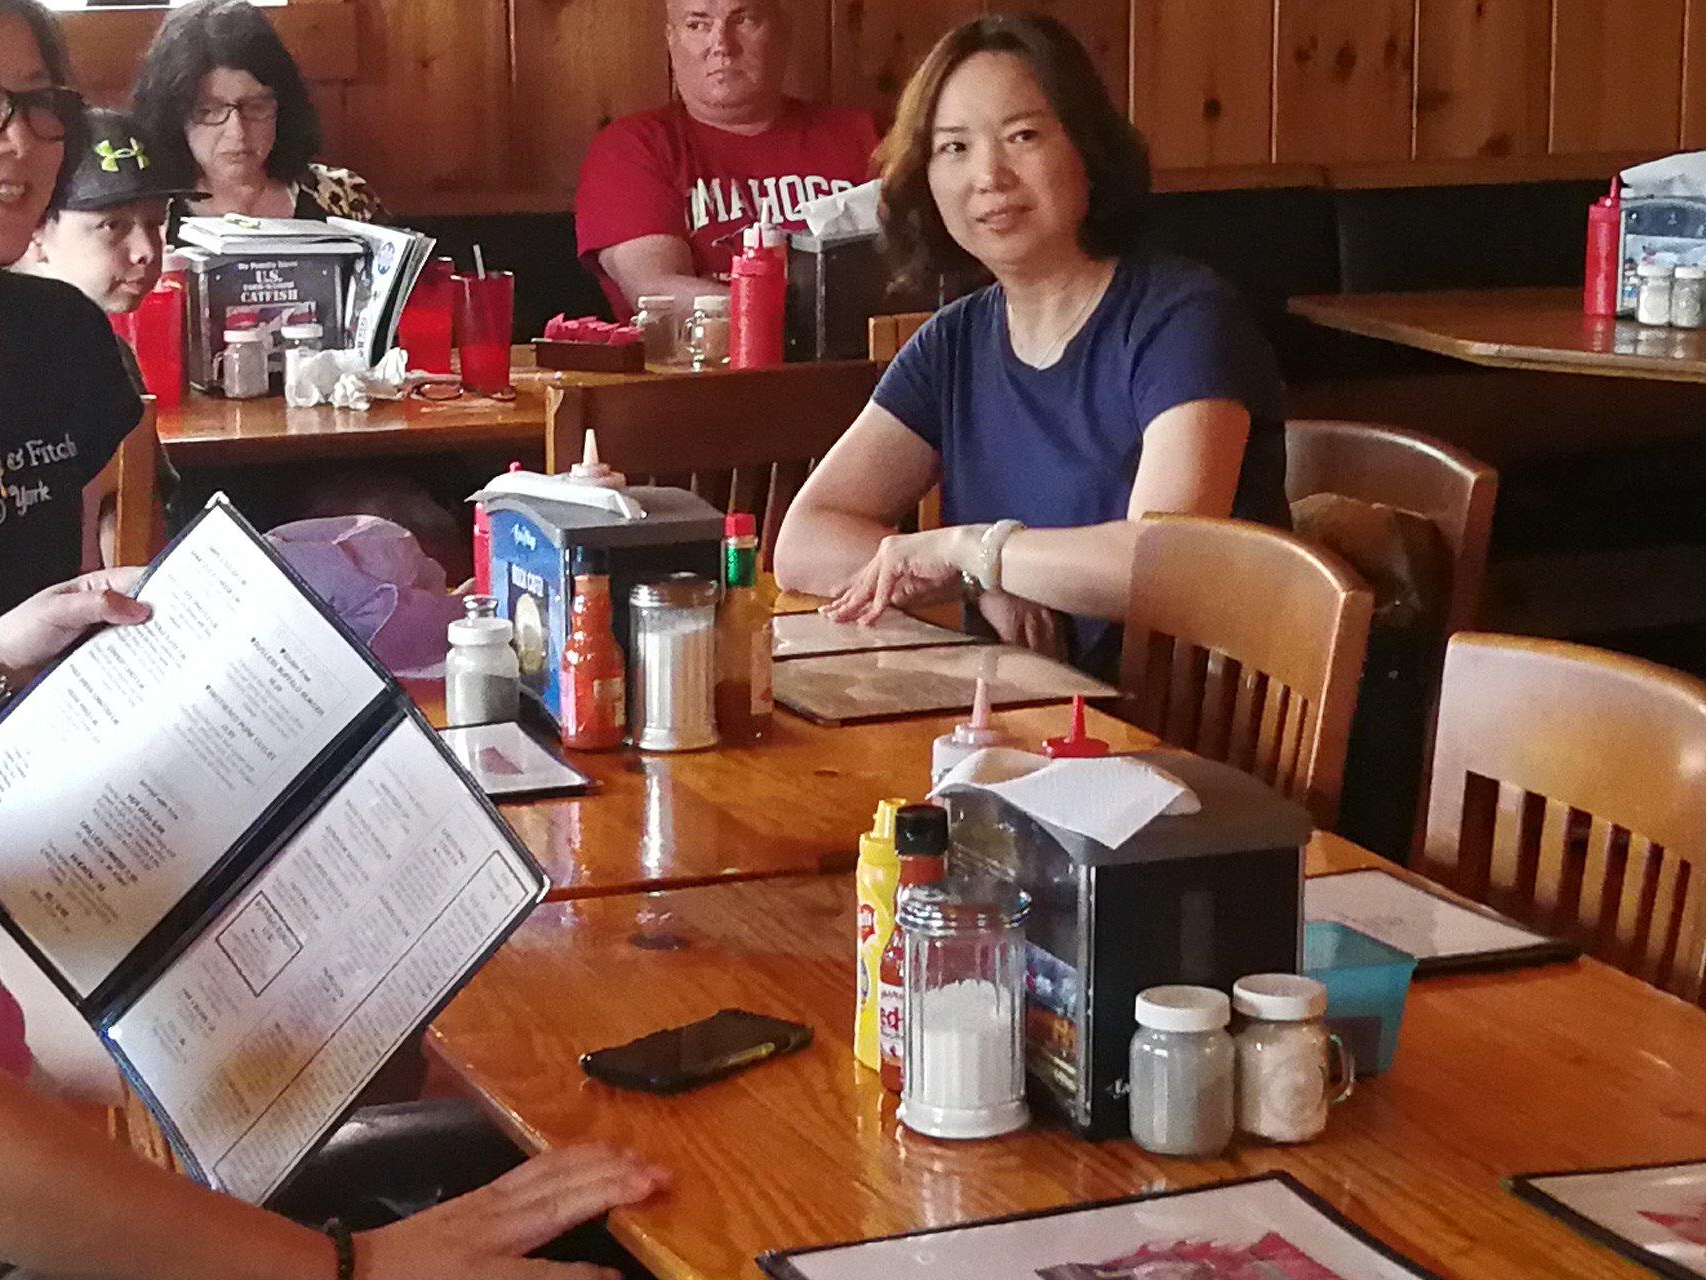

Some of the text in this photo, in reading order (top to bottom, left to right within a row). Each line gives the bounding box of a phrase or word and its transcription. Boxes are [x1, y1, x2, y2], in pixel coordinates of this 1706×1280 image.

[255, 269, 284, 284] U.S.
[240, 289, 298, 303] CATFISH
[25, 433, 78, 467] Fitch
[8, 480, 53, 516] York
